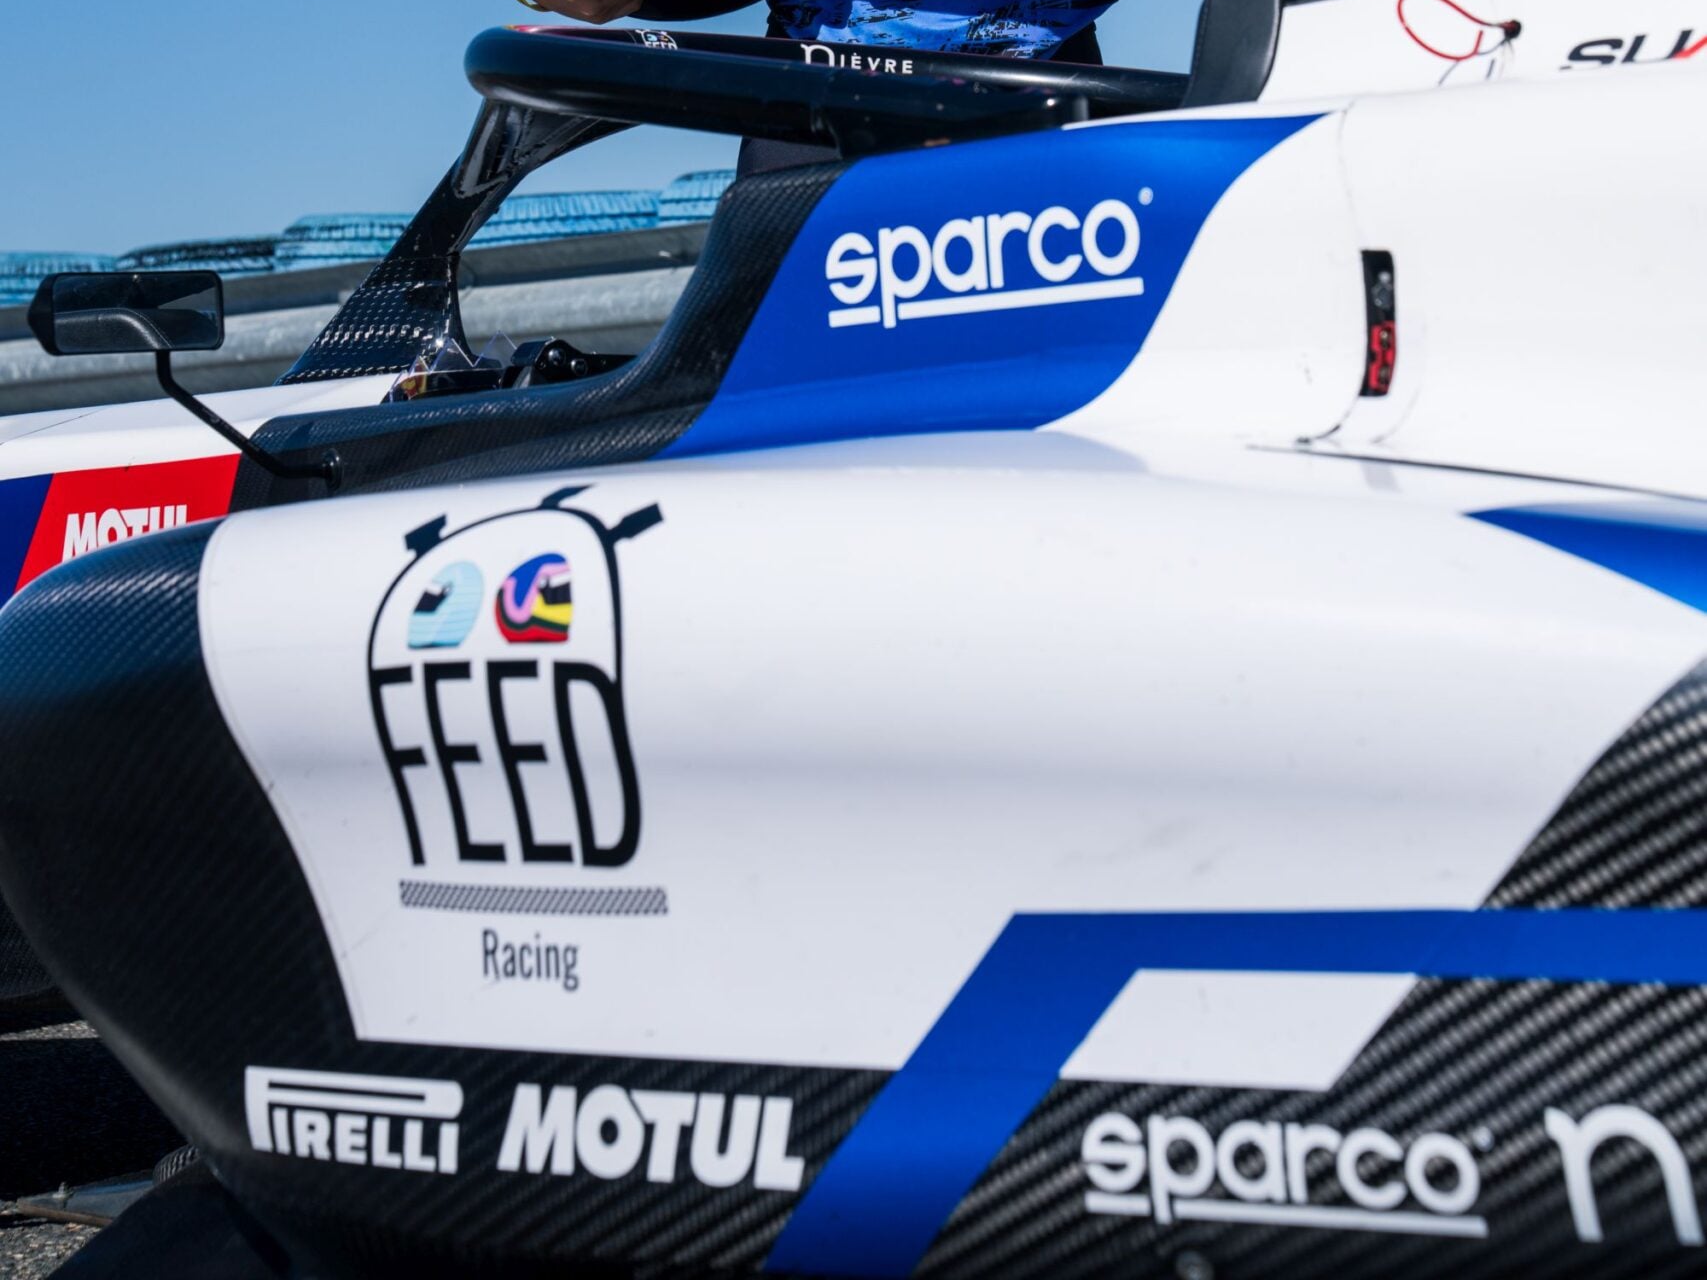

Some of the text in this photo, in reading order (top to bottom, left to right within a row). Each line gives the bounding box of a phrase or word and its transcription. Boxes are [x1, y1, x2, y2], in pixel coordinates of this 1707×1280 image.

[825, 199, 1141, 329] sparco
[368, 660, 642, 868] FEED
[482, 929, 579, 992] Racing
[245, 1066, 463, 1174] PIRELLI
[497, 1083, 805, 1192] MOTUL
[1081, 1112, 1481, 1224] sparco
